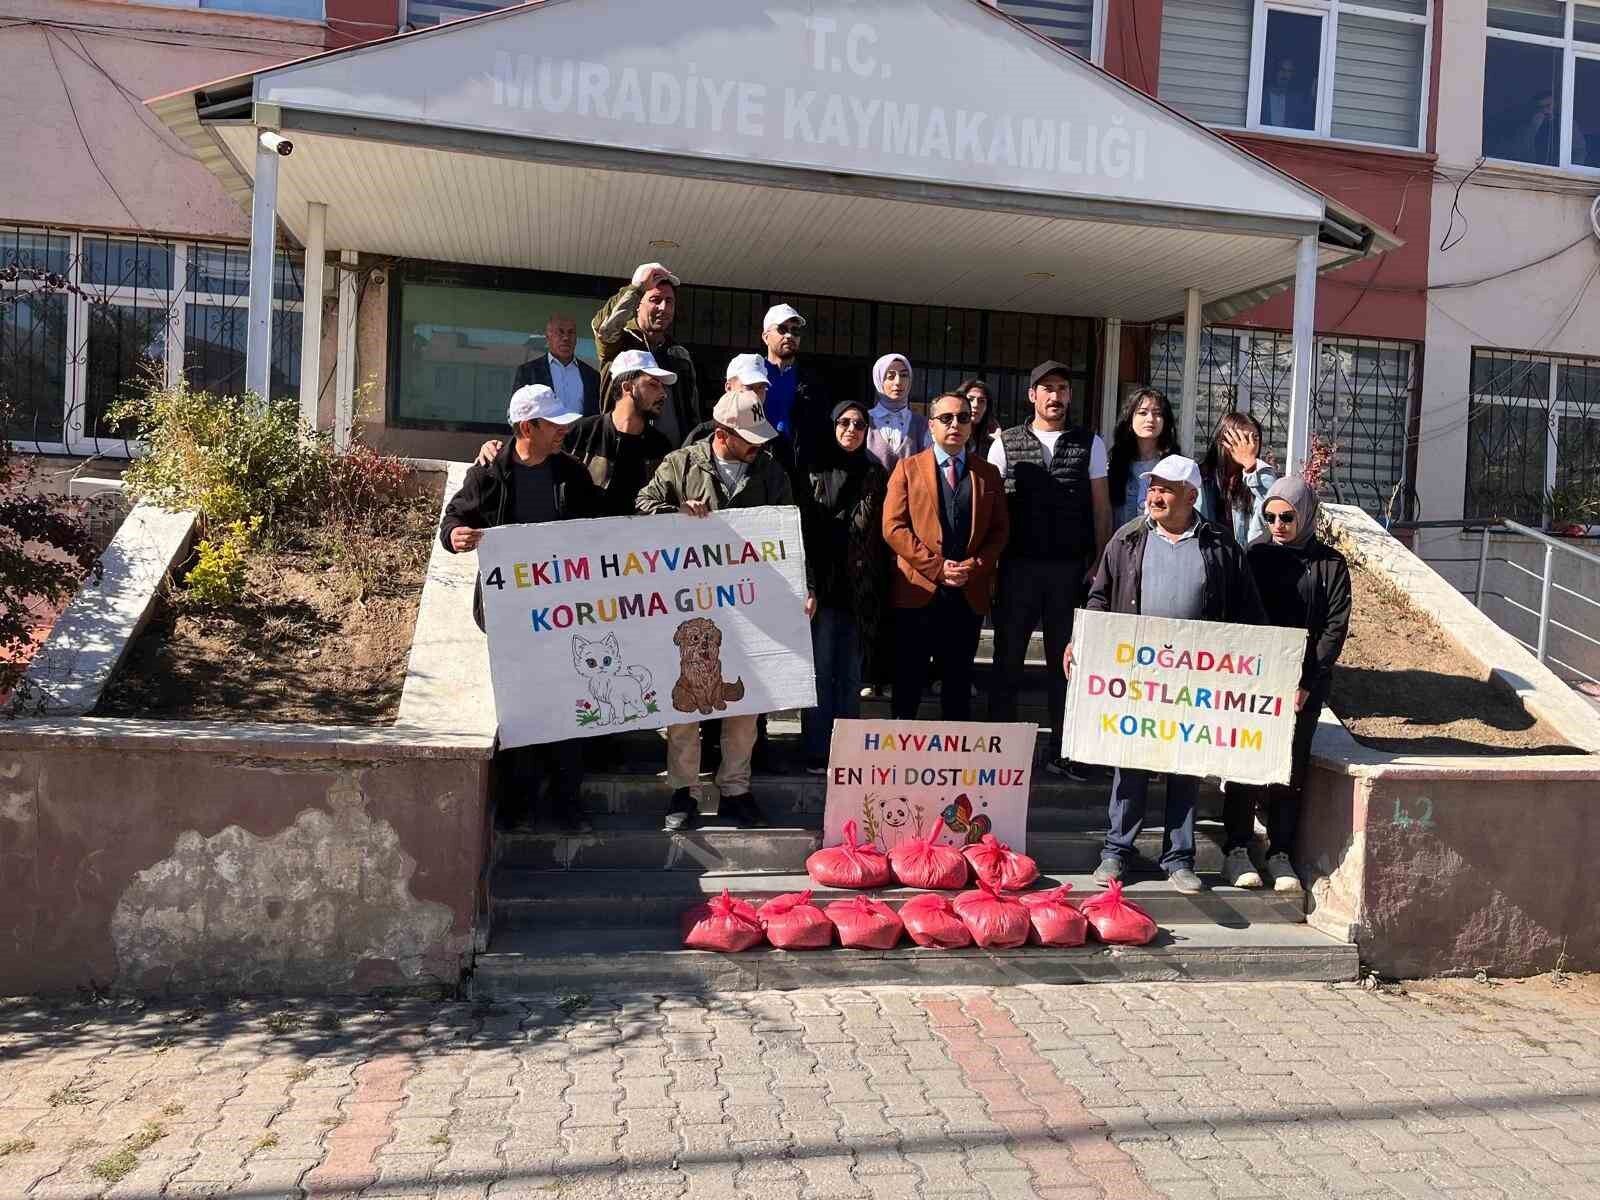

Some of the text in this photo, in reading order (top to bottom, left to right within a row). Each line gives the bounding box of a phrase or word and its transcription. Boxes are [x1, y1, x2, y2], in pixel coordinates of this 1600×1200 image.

[803, 16, 891, 78] T.C.
[493, 51, 1145, 180] MURADİYE KAYMAKAMLIĞI
[486, 539, 786, 590] 4 EKİM HAYVANLARI
[531, 578, 756, 632] KORUMA GÜNÜ
[1115, 643, 1264, 676] DOĞADAKİ
[1087, 674, 1283, 717] DOSTLARIMIZI
[864, 733, 1002, 754] HAYVANLAR
[1102, 713, 1263, 752] KORUYALIM
[834, 764, 1024, 786] EN İYİ DOSTUMUZ
